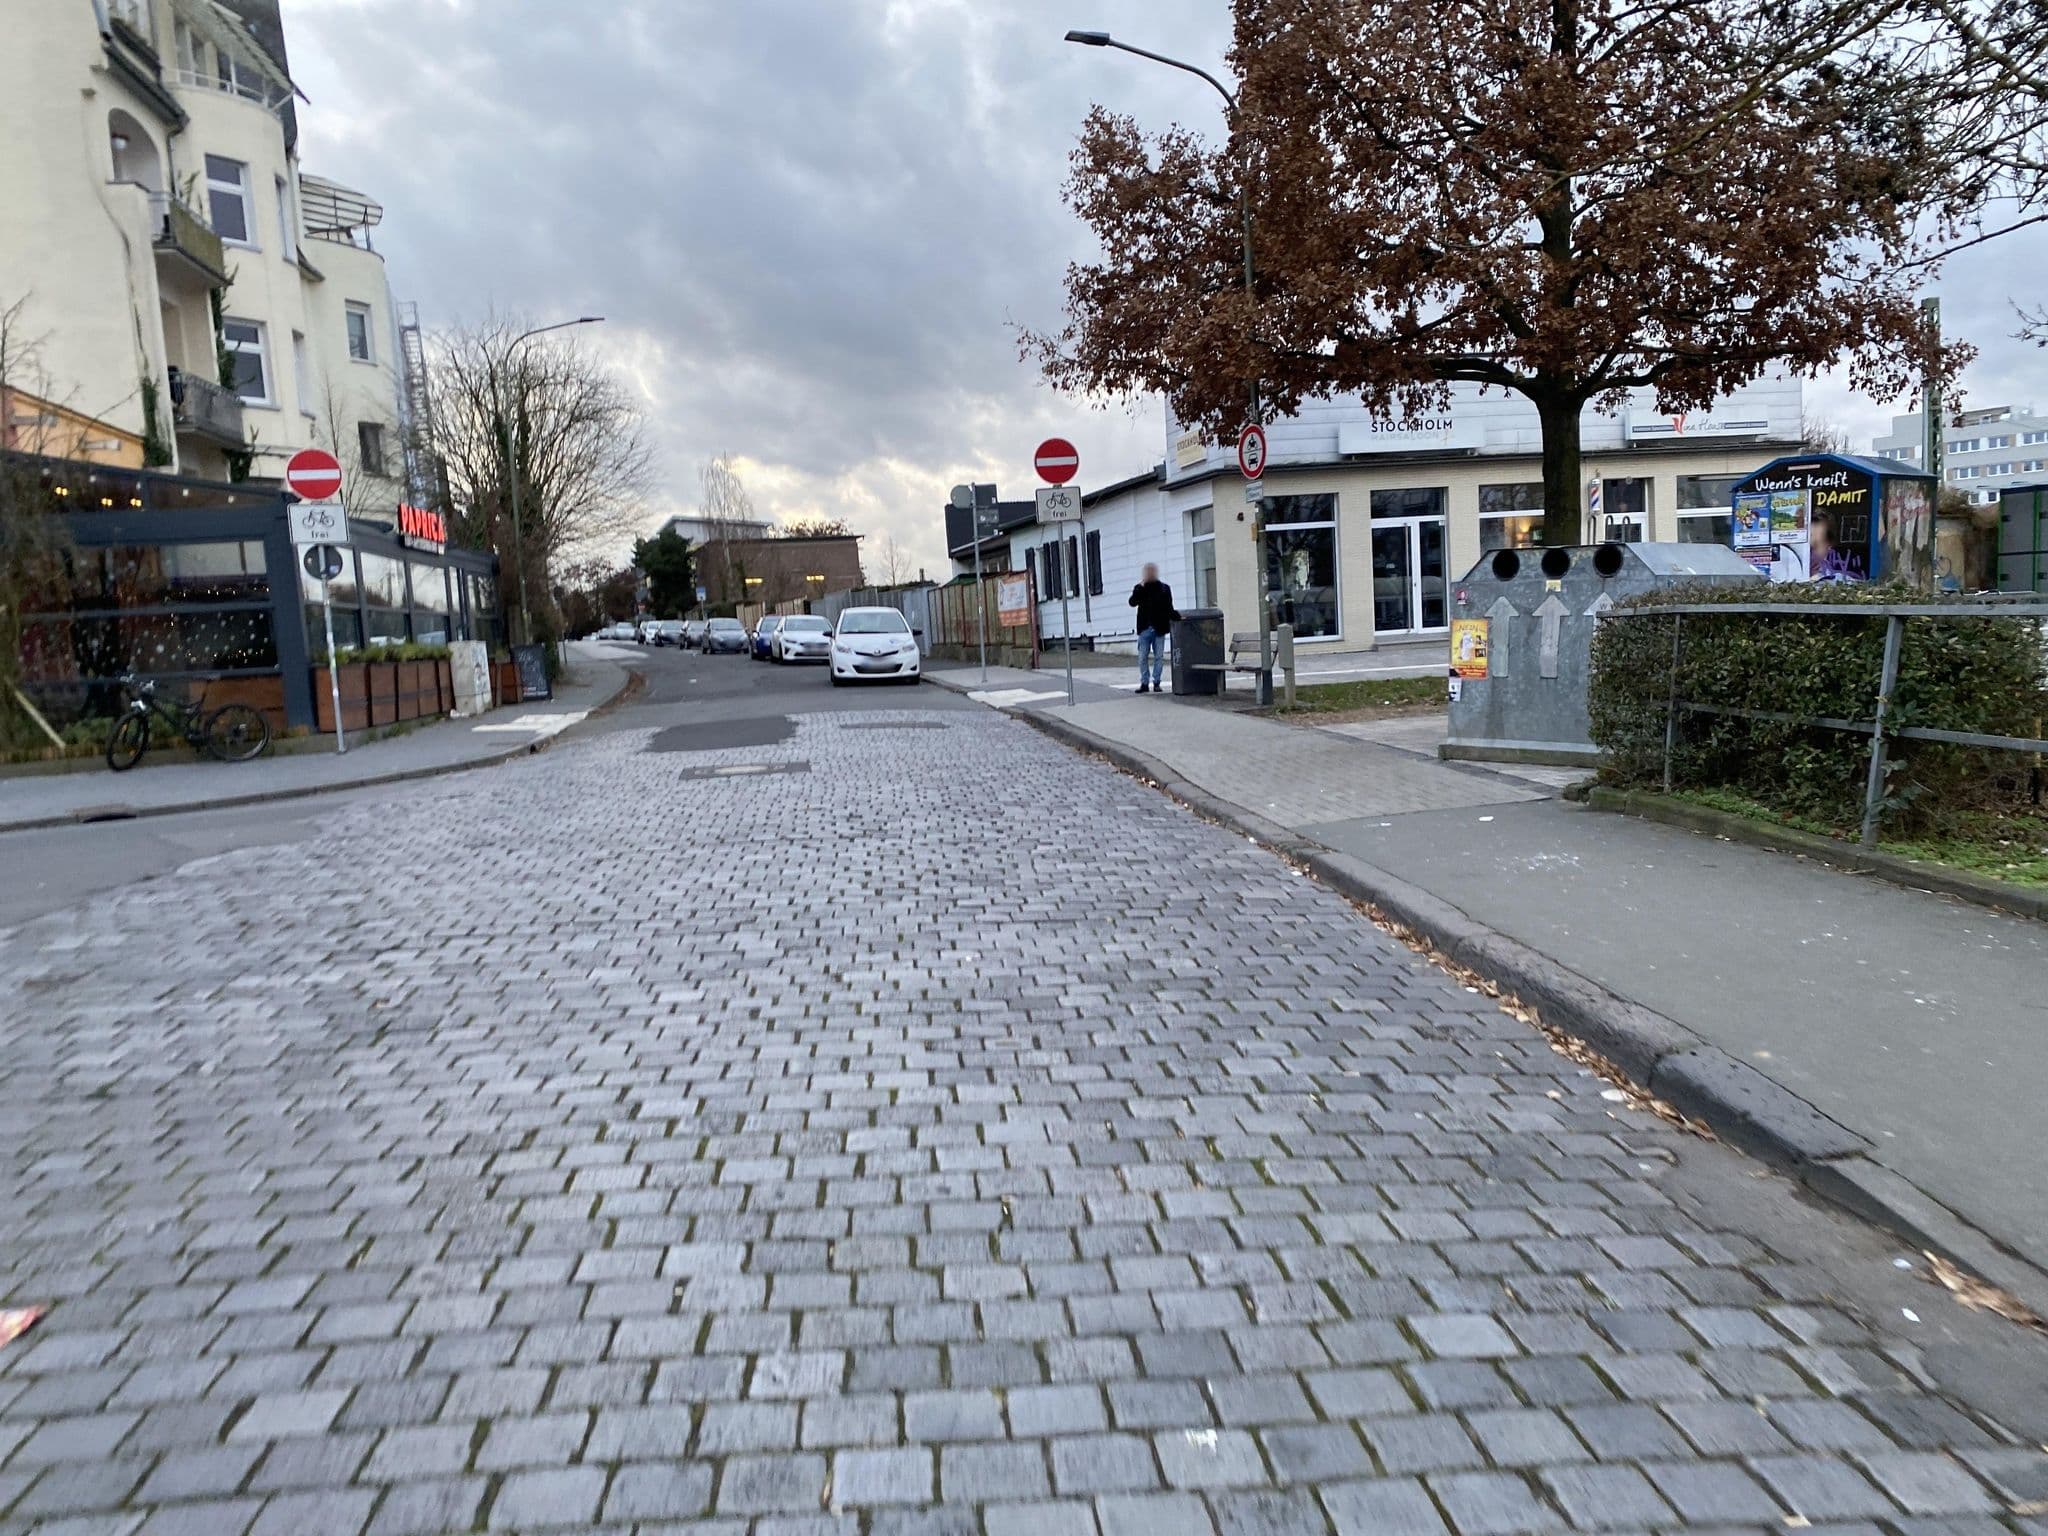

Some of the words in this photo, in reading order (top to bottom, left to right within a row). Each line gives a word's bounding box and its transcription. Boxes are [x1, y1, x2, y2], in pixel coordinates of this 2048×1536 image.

[1371, 419, 1453, 433] STOCKHOLM
[1755, 475, 1802, 491] Wenn's
[1807, 471, 1848, 488] kneift
[1816, 489, 1867, 506] DAMIT
[1053, 510, 1067, 518] frei
[400, 502, 445, 544] PAPRICA
